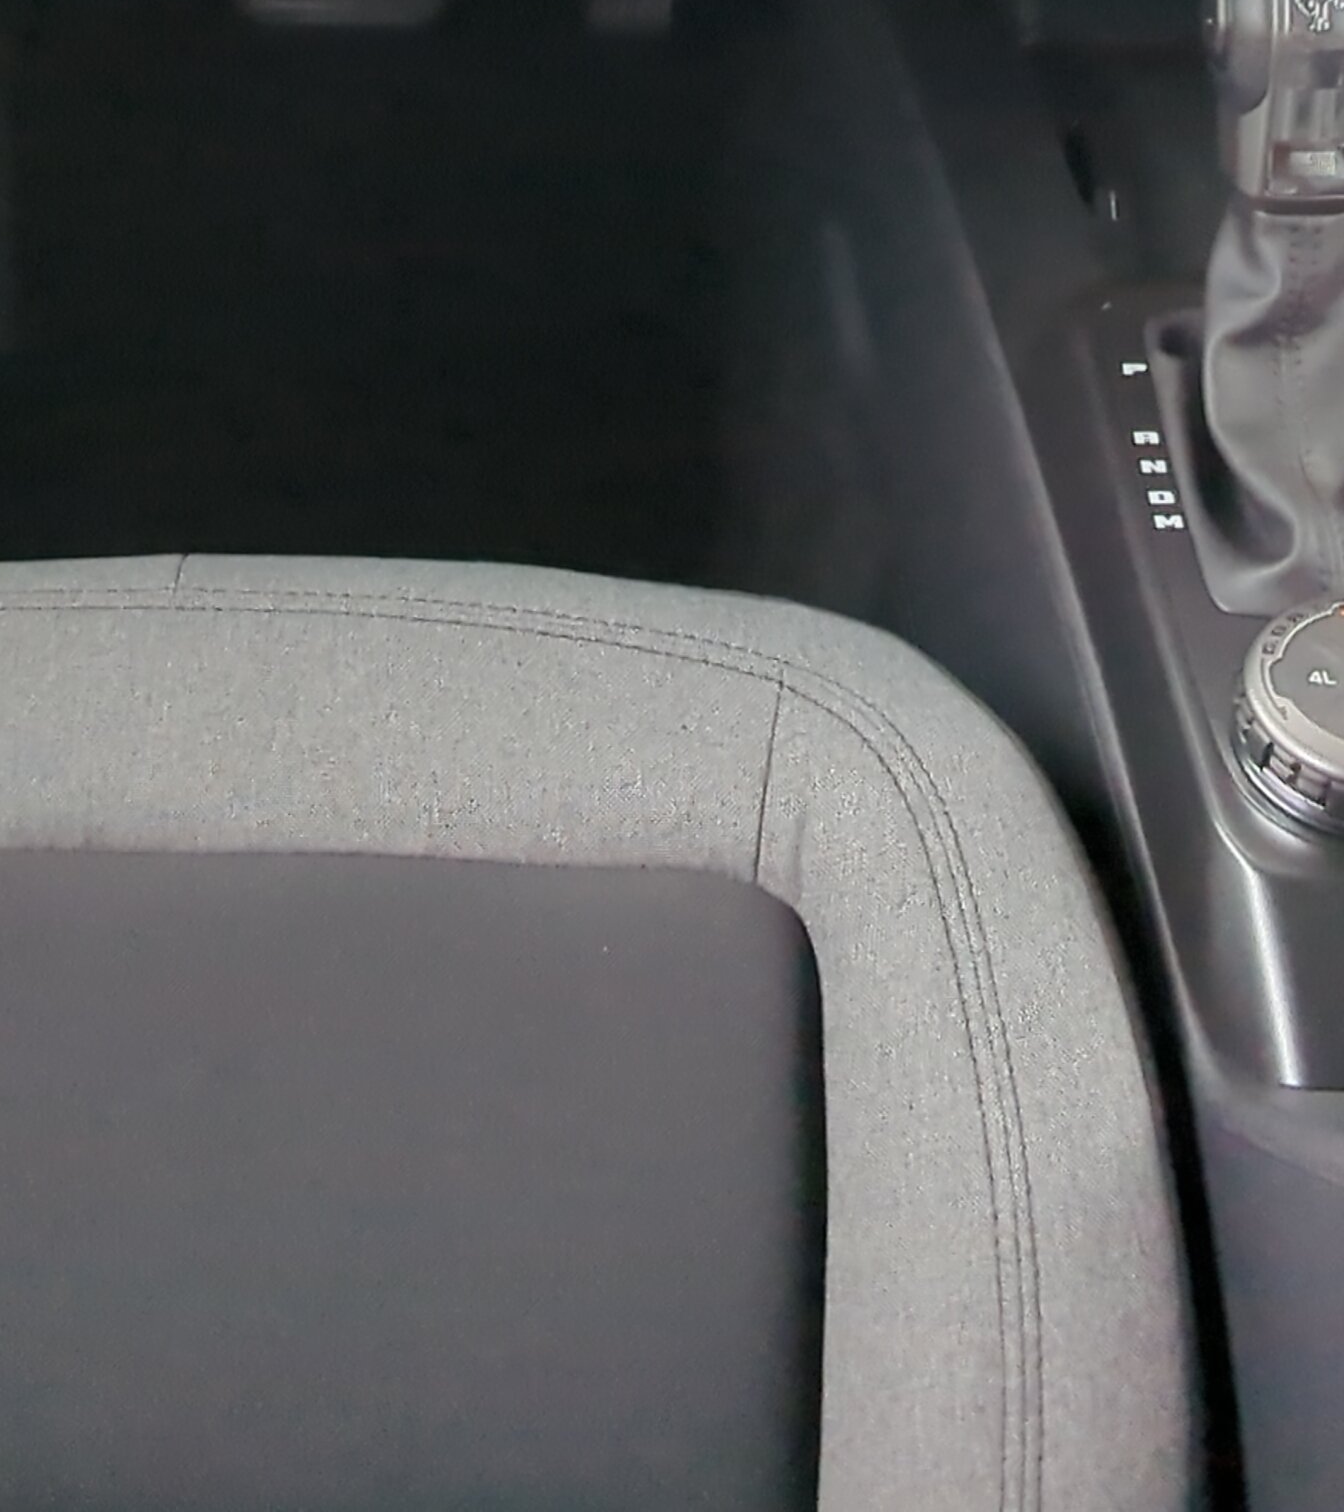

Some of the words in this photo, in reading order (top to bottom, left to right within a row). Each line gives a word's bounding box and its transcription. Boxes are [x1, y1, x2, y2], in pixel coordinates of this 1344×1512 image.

[1140, 459, 1168, 474] N
[1147, 490, 1176, 505] D
[1153, 514, 1185, 529] M
[1308, 670, 1338, 686] 4L
